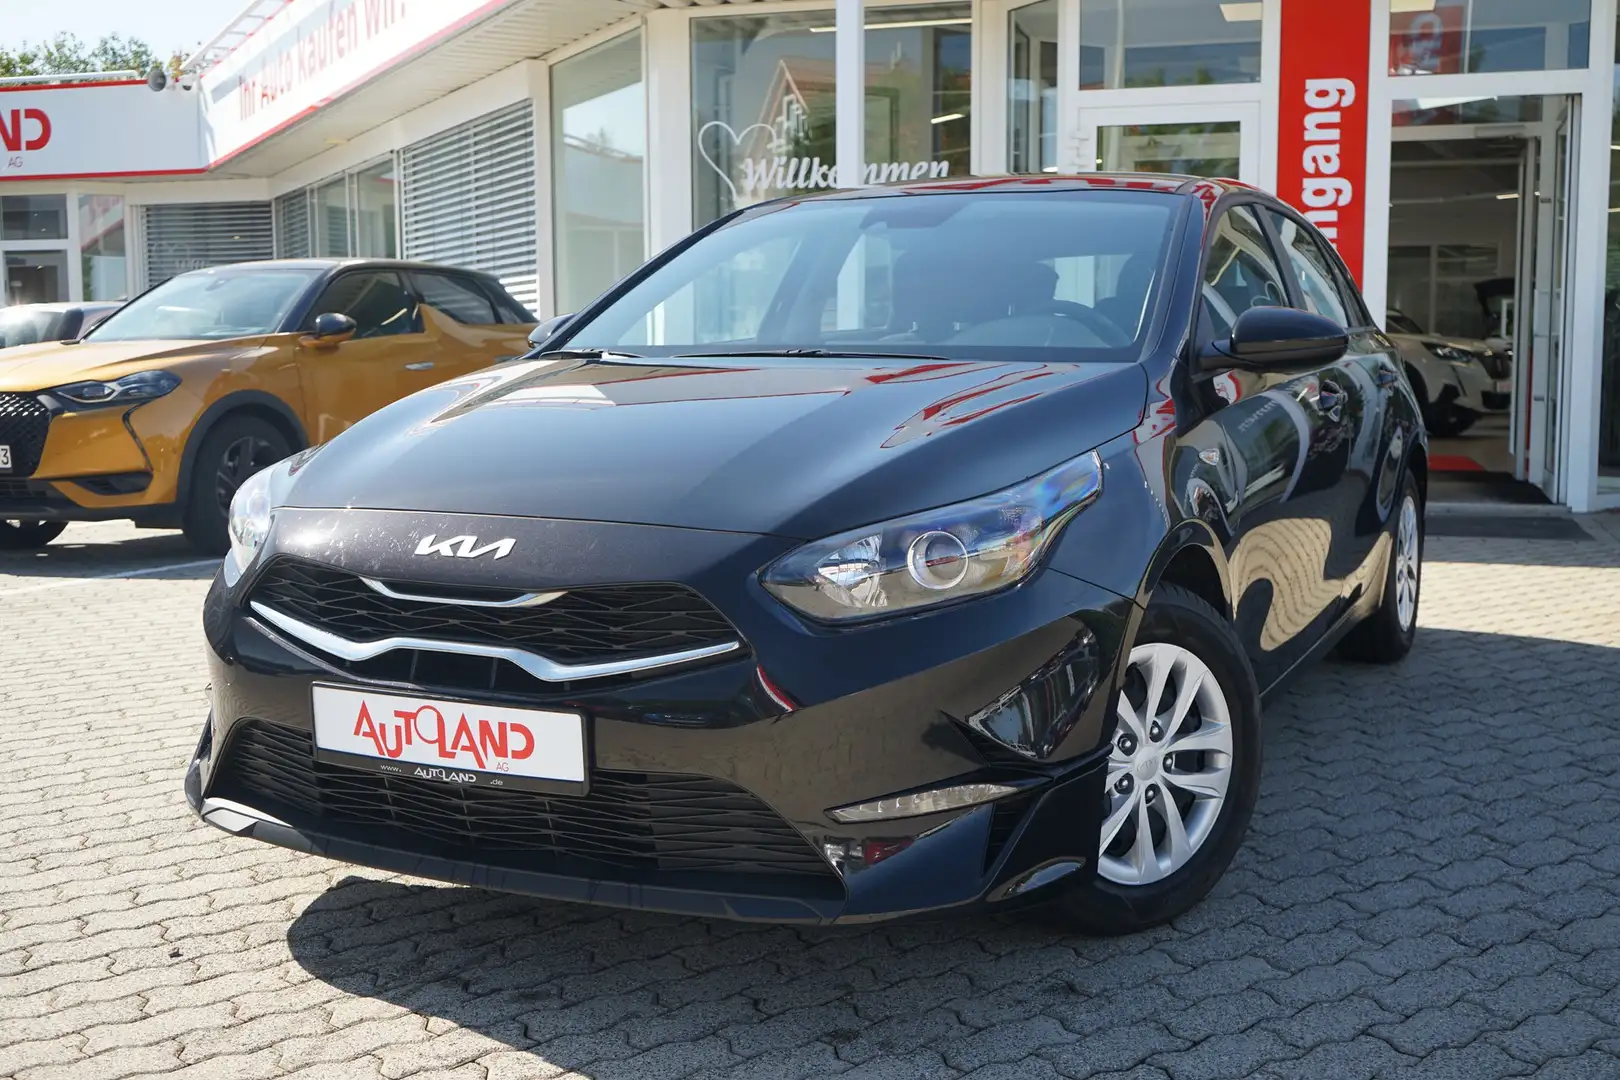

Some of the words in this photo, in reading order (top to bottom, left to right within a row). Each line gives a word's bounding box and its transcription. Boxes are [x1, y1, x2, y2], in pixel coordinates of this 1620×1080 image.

[260, 50, 294, 108] Auto
[296, 0, 358, 84] kaufen
[8, 156, 23, 168] AG
[1301, 77, 1356, 249] ngang
[414, 534, 517, 560] KIA
[353, 700, 535, 769] AUTOLAND
[414, 767, 476, 782] AUTOLAND
[496, 762, 509, 772] AG
